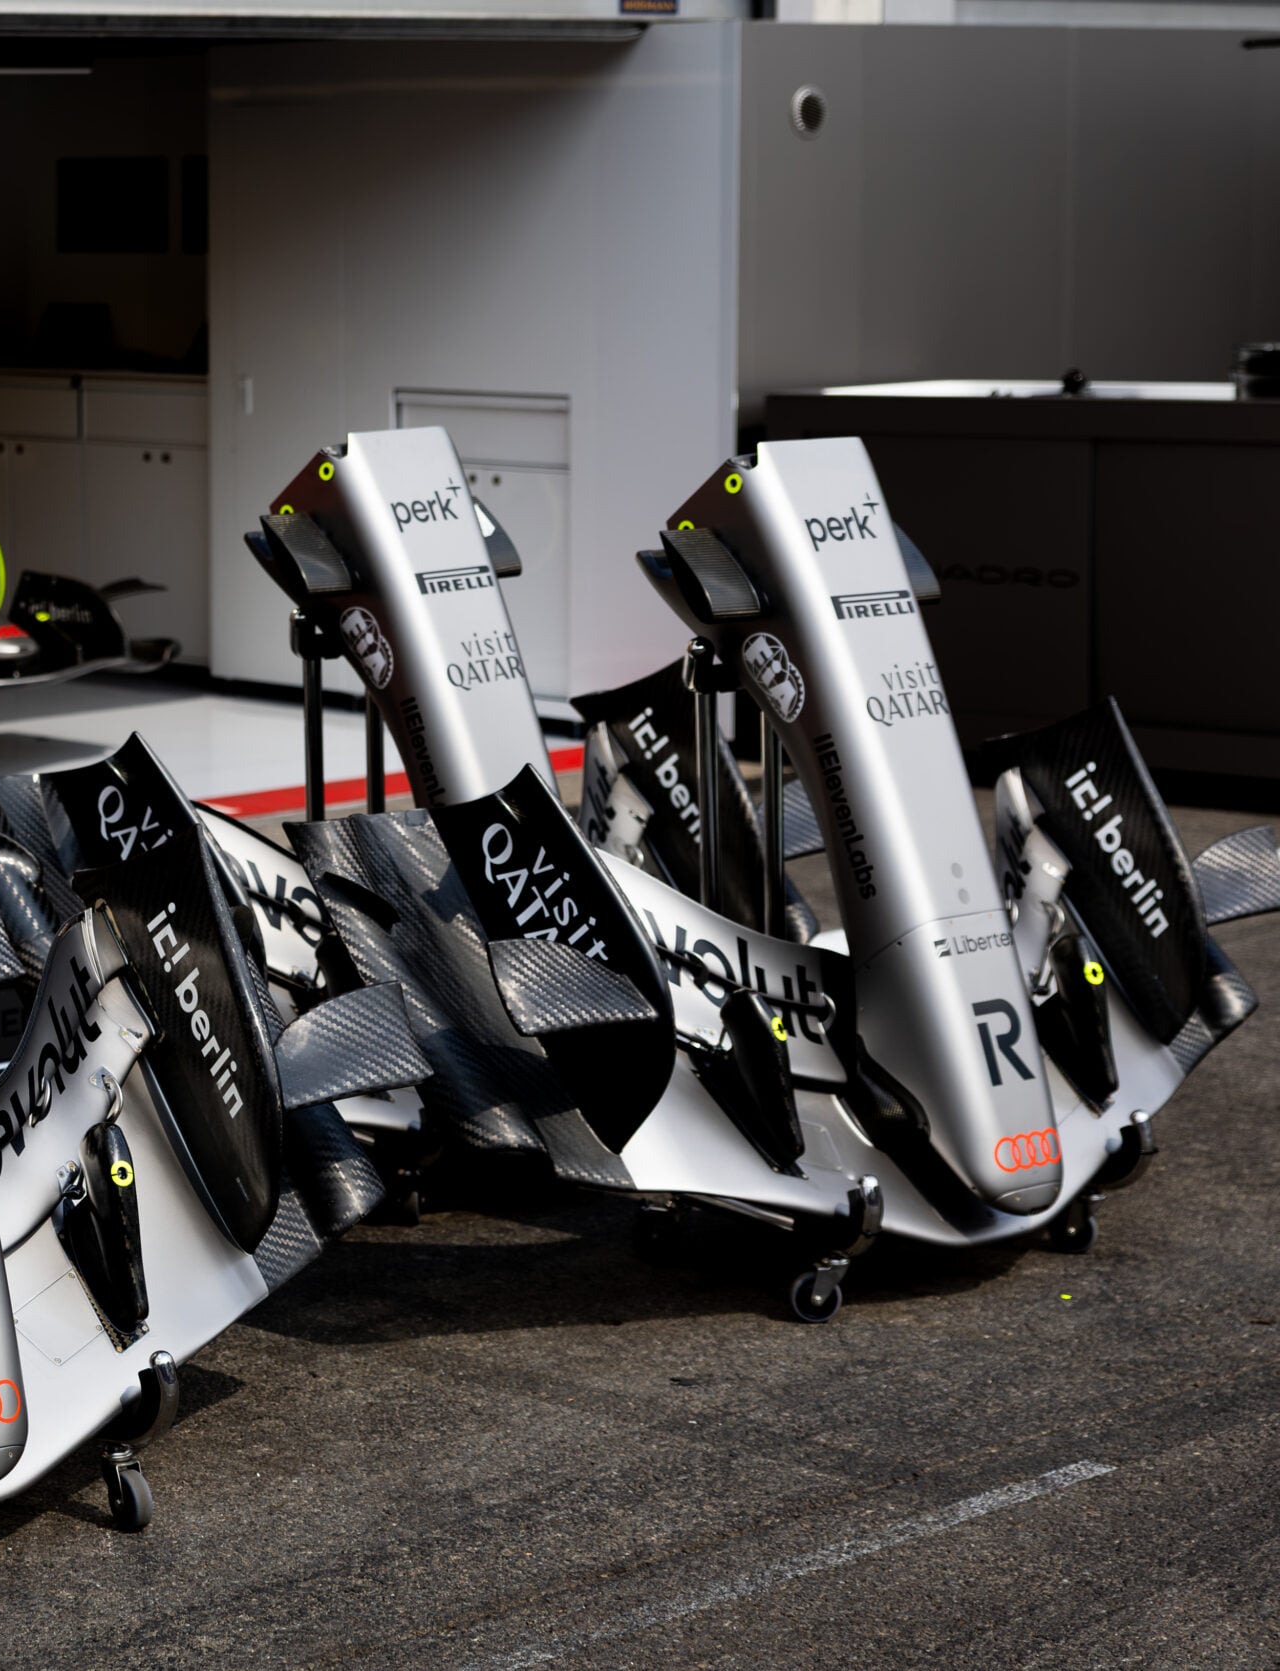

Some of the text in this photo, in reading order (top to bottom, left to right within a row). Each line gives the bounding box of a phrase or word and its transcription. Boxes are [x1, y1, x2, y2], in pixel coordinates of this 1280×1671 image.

[415, 565, 494, 595] PIRELLI
[830, 590, 915, 620] PIRELLI
[461, 630, 517, 658] visit
[446, 655, 525, 691] QATAR
[881, 661, 939, 692] visit
[866, 689, 950, 727] QATAR
[1094, 814, 1169, 938] berlin
[532, 845, 609, 961] visit
[952, 931, 1013, 955] Liberte
[642, 908, 823, 1046] volut
[174, 967, 244, 1119] berlin
[972, 998, 1036, 1087] R
